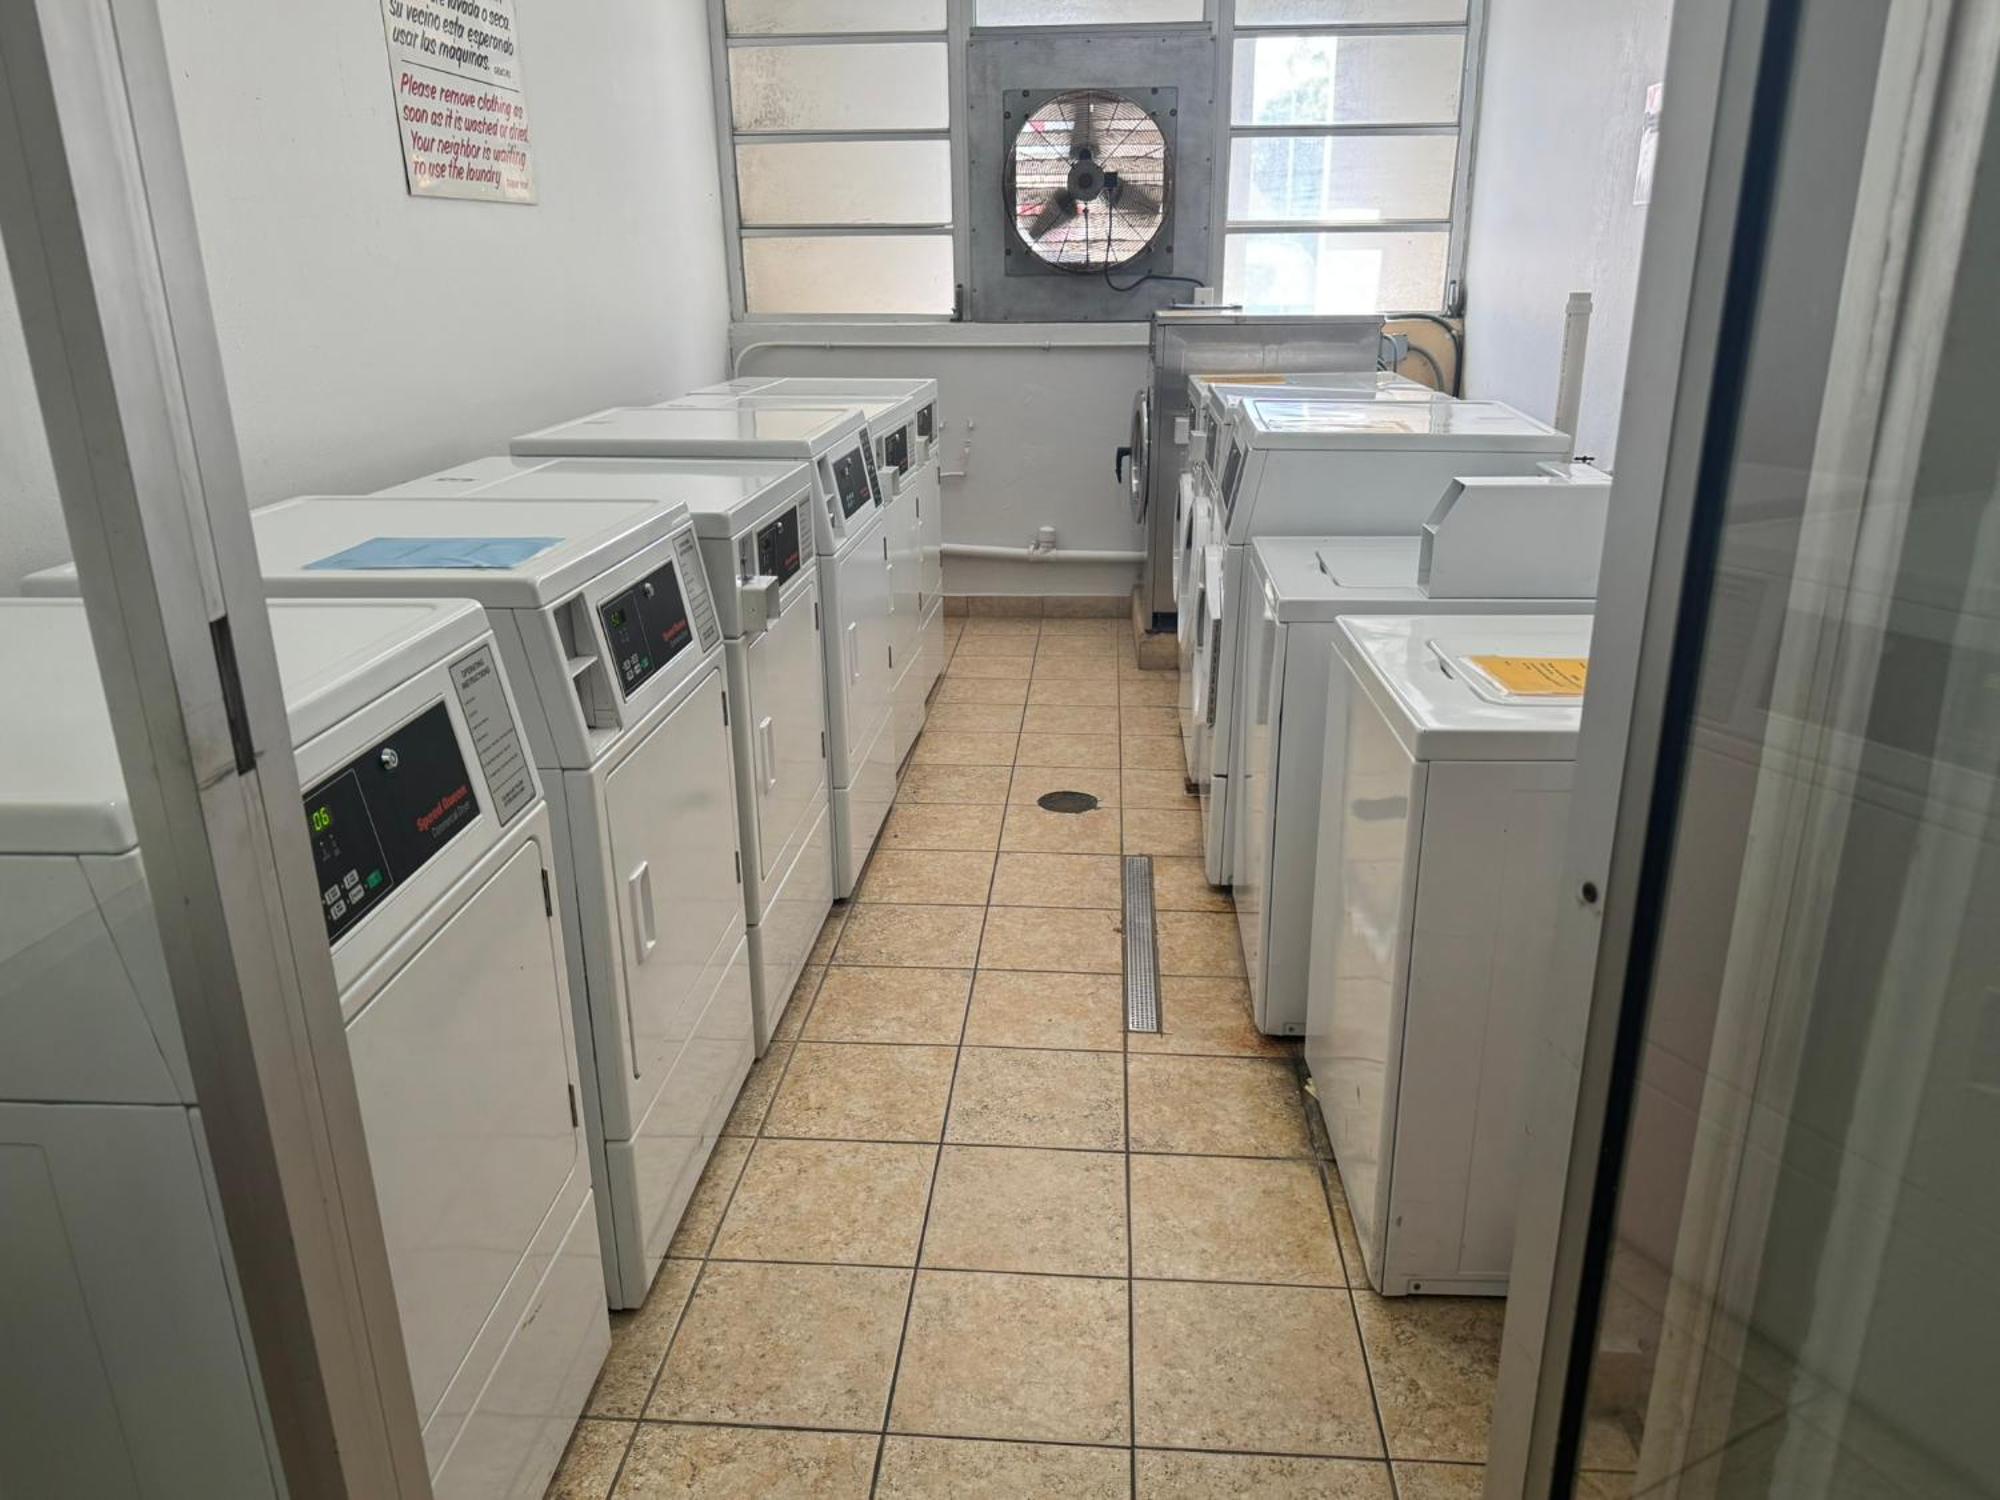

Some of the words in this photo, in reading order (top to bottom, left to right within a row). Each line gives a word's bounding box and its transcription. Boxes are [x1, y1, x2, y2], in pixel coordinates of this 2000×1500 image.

[389, 0, 404, 18] Su
[406, 4, 441, 31] vecino
[467, 27, 514, 56] esperando
[481, 8, 487, 22] o
[392, 26, 419, 49] usar
[420, 30, 437, 55] las
[400, 72, 437, 101] Please
[440, 87, 476, 108] remove
[477, 91, 512, 121] clothing
[513, 105, 523, 121] as
[403, 104, 428, 124] soon
[431, 111, 443, 127] as
[445, 107, 453, 129] it
[454, 110, 463, 131] is
[464, 116, 498, 136] washed
[499, 123, 509, 138] or
[410, 129, 435, 153] Your
[437, 135, 481, 162] neighbor
[482, 140, 491, 161] is
[493, 142, 527, 172] waiting
[428, 161, 447, 178] use
[448, 159, 464, 181] the
